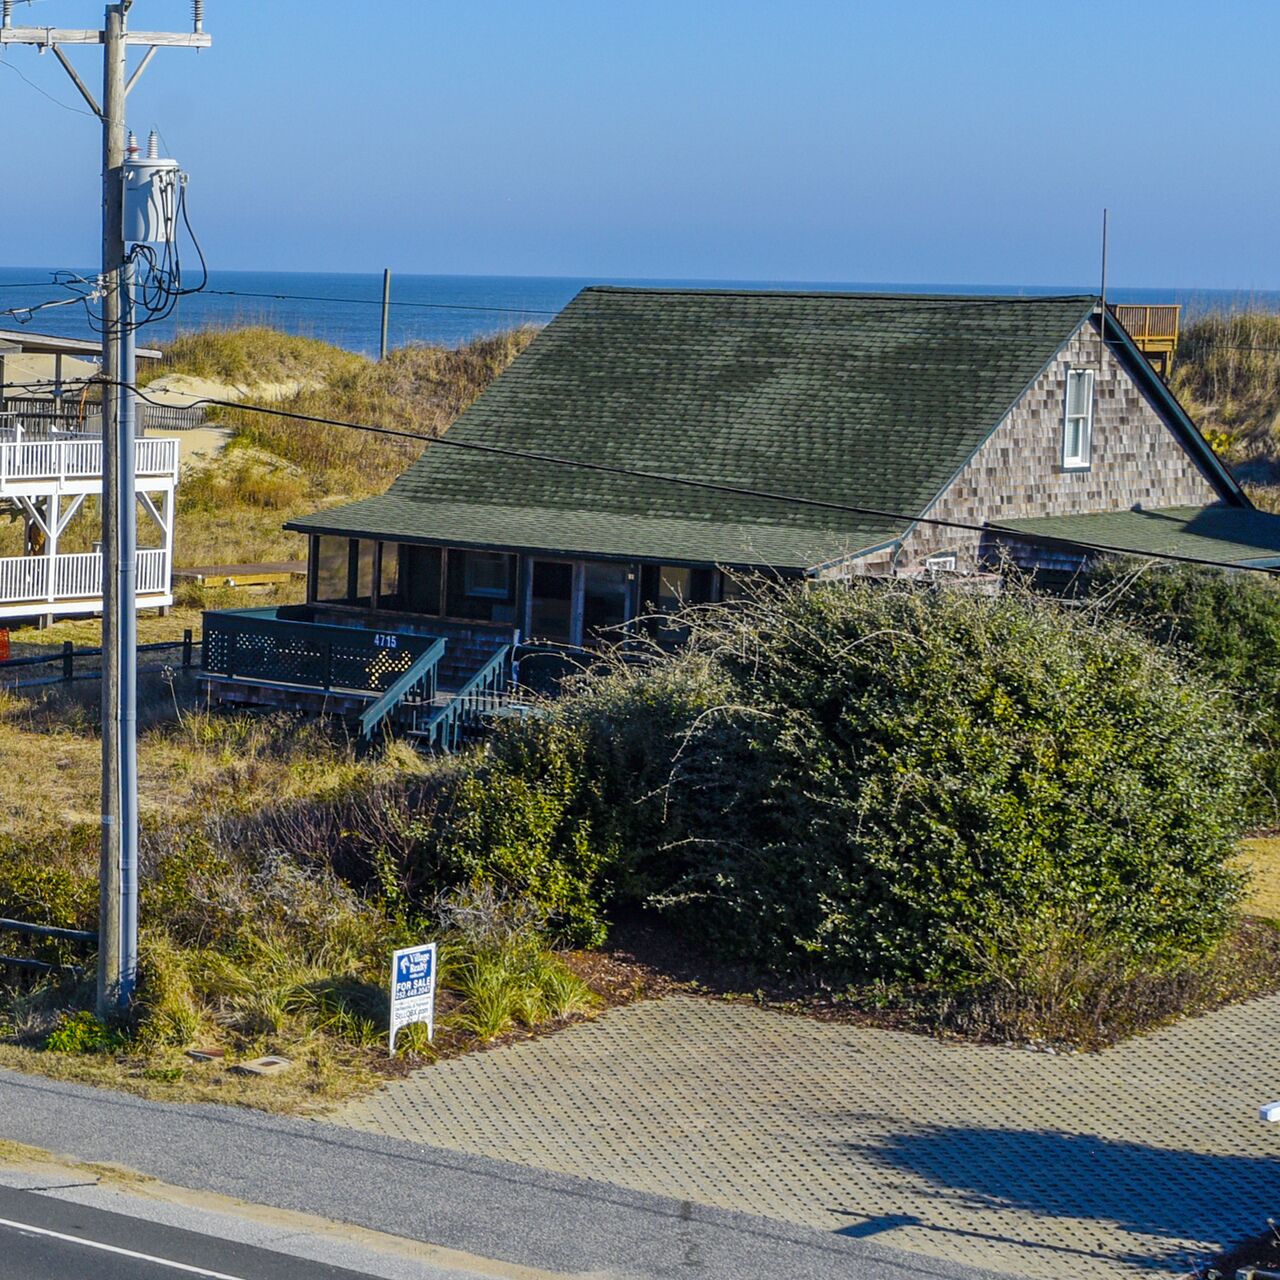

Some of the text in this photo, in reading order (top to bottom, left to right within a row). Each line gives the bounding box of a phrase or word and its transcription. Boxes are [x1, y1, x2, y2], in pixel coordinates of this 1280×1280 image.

[374, 634, 397, 648] 4715
[409, 952, 430, 964] Village
[397, 977, 431, 992] FOR SALE
